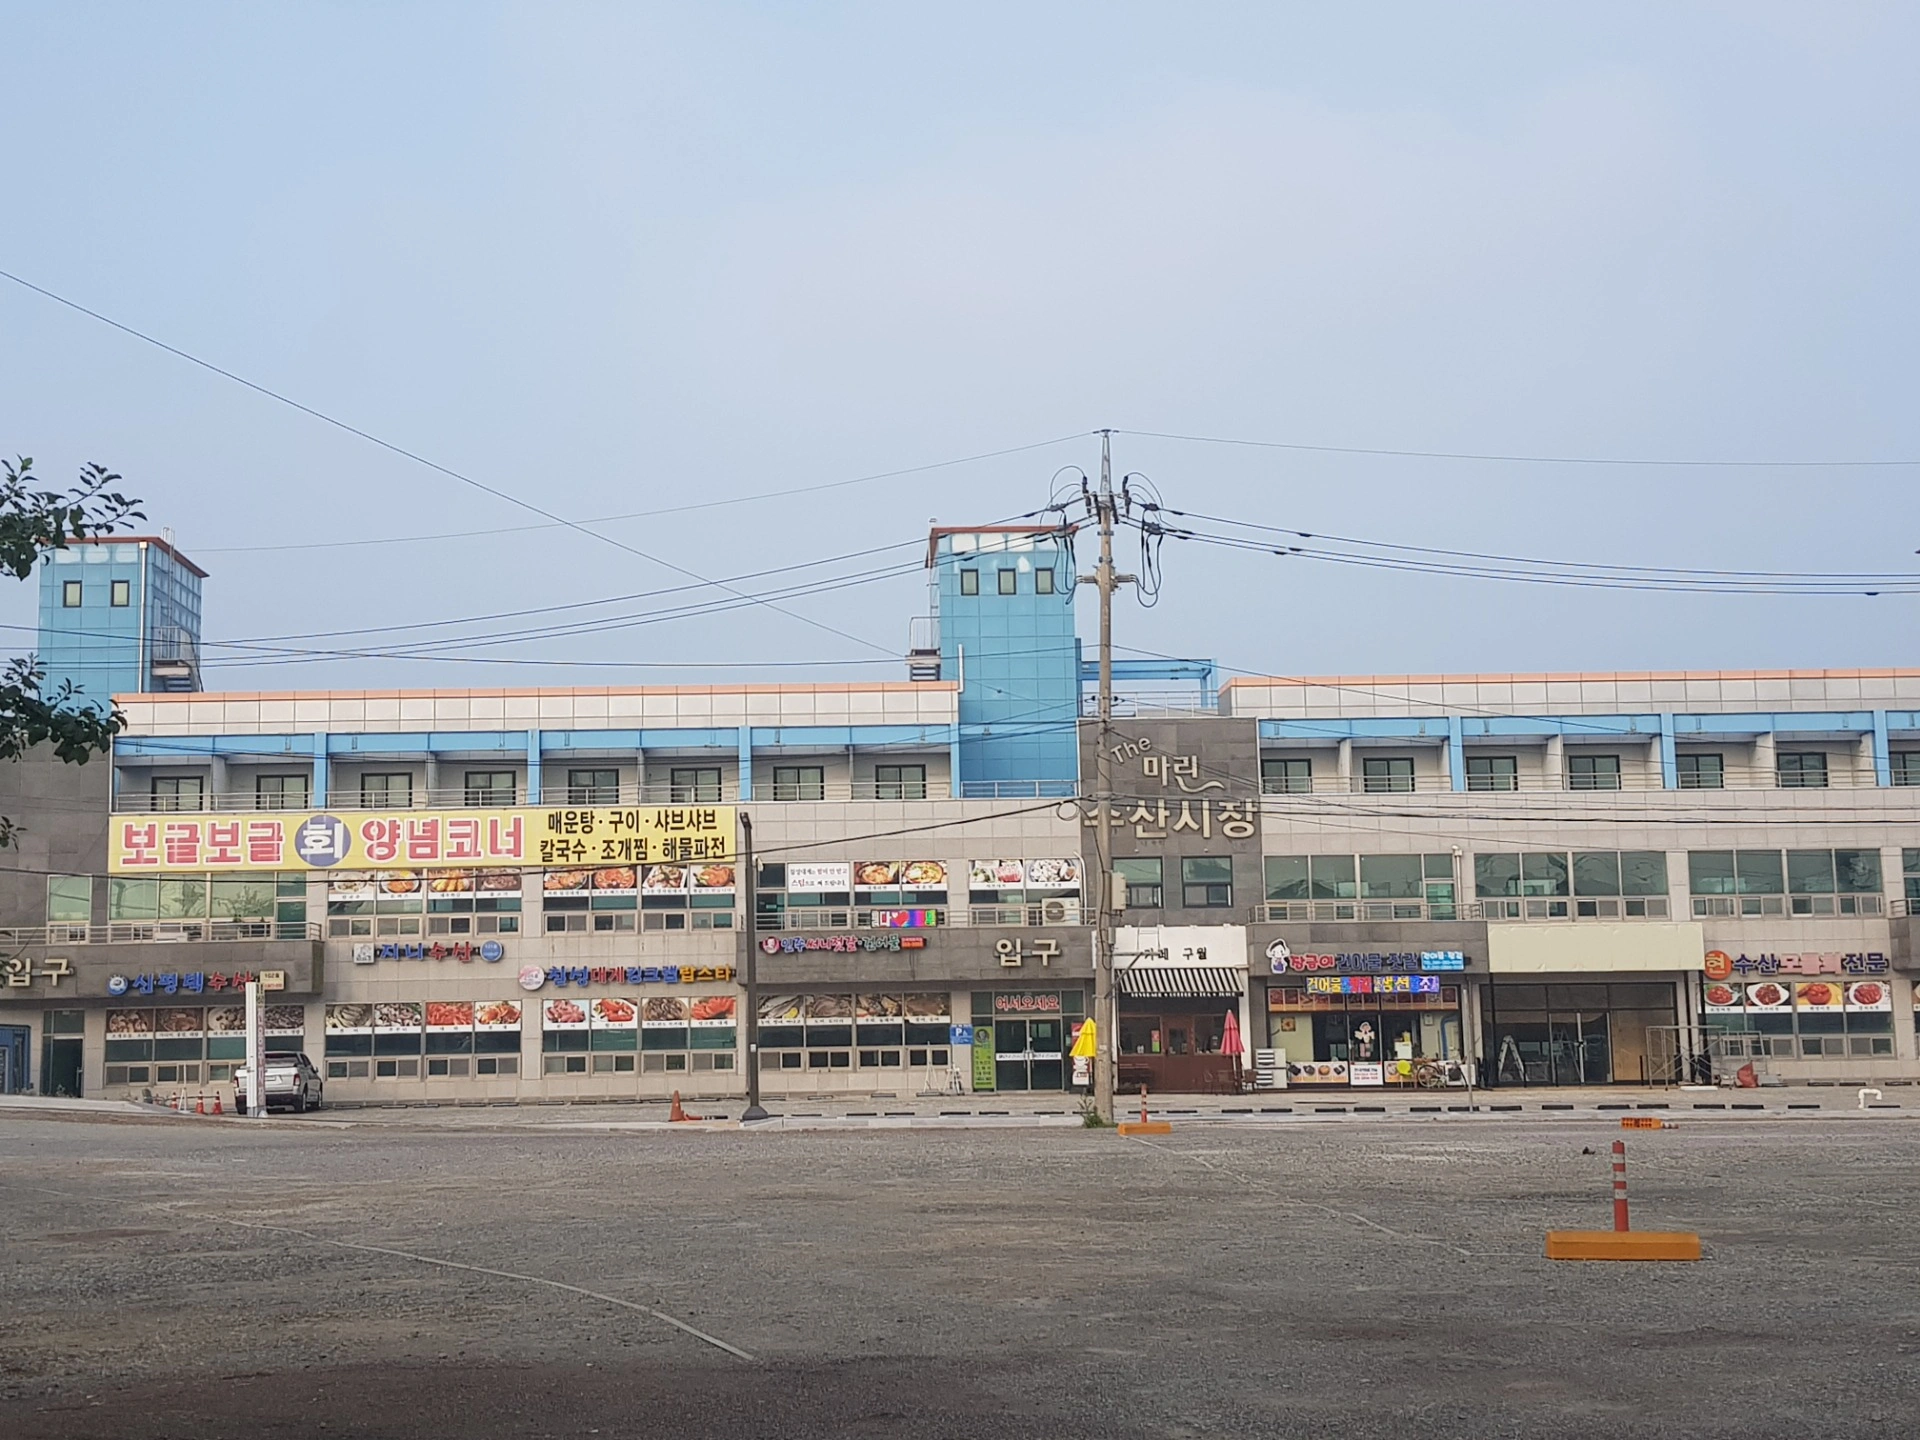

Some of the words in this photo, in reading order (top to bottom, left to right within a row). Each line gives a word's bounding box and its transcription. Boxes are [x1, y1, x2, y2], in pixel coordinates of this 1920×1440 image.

[1110, 736, 1152, 764] The
[1143, 755, 1225, 793] 마린
[654, 808, 718, 833] 샤브샤브
[1083, 798, 1258, 839] 수산시장
[121, 819, 284, 867] 보글보글
[300, 821, 345, 860] 회
[361, 815, 524, 863] 양념코너
[662, 835, 726, 861] 해물파전
[996, 938, 1060, 967] 입구
[1336, 952, 1382, 972] 건어물
[6, 957, 71, 987] 입구
[995, 994, 1060, 1011] 어서오세요
